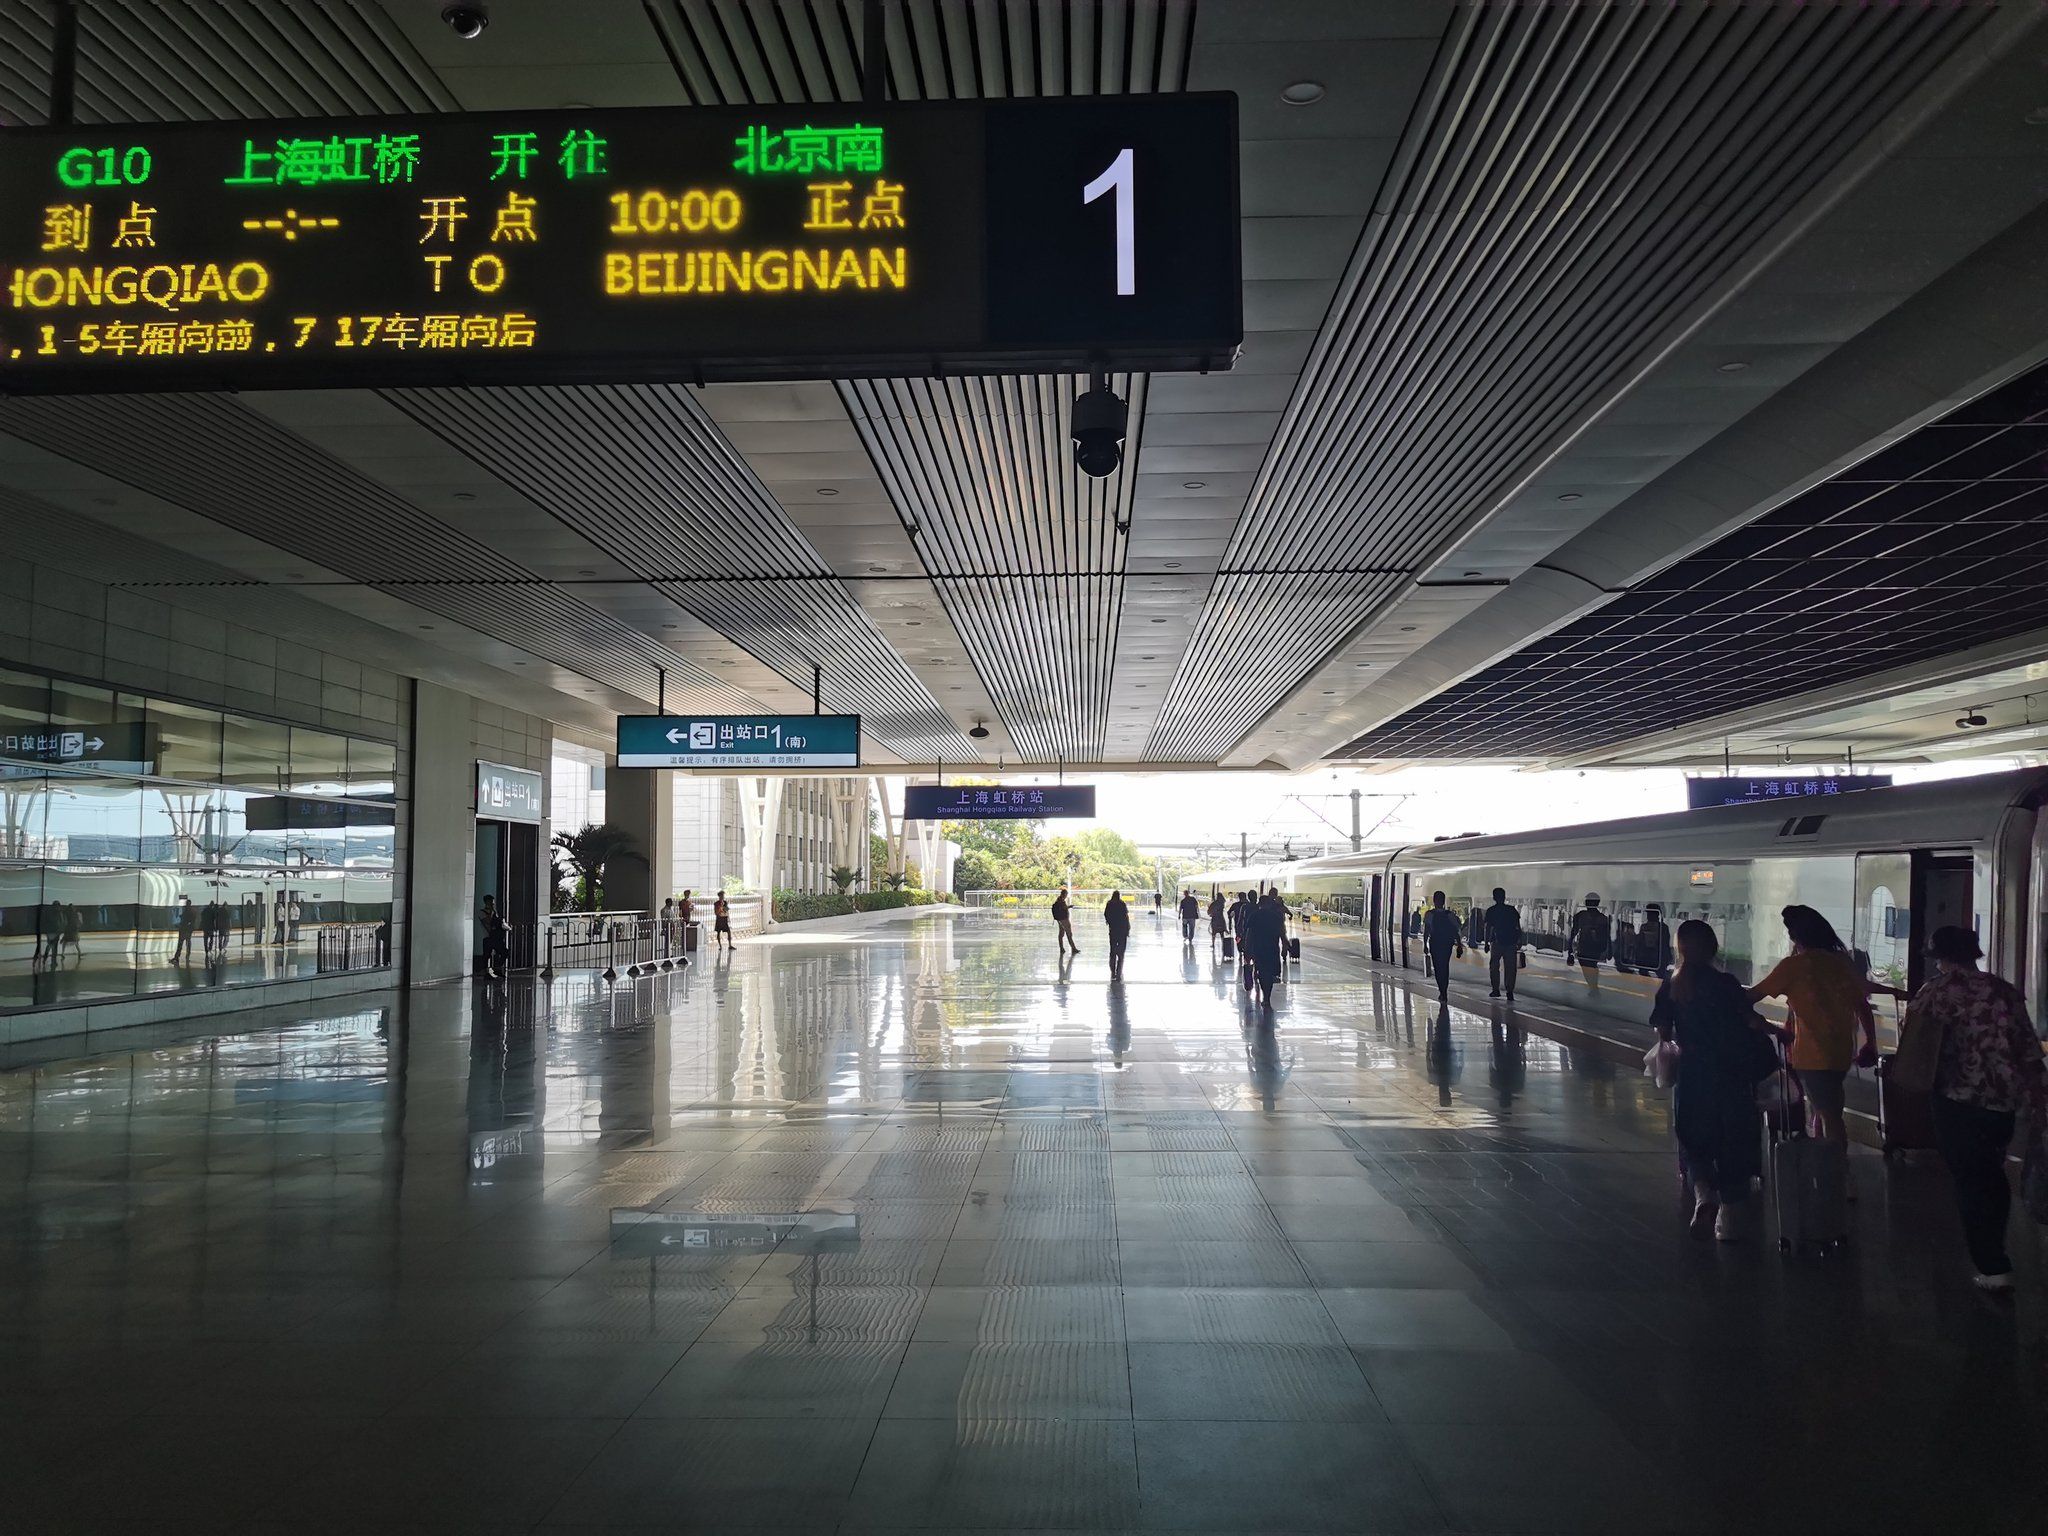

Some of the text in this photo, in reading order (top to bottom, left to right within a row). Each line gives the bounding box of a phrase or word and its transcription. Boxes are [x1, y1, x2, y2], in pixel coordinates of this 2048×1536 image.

[58, 147, 151, 187] G10
[224, 135, 420, 186] 上海虹桥
[734, 123, 883, 176] 北京南
[611, 189, 742, 234] 10:00
[804, 180, 904, 229] 正点
[1083, 148, 1136, 296] 1
[605, 248, 906, 295] BEIJINGNAN
[937, 806, 970, 814] Shanghai
[973, 806, 1006, 814] Hongqiao
[1008, 806, 1037, 814] Railway
[957, 790, 1044, 805] 上海虹桥站
[1745, 781, 1838, 796] 上海虹桥站
